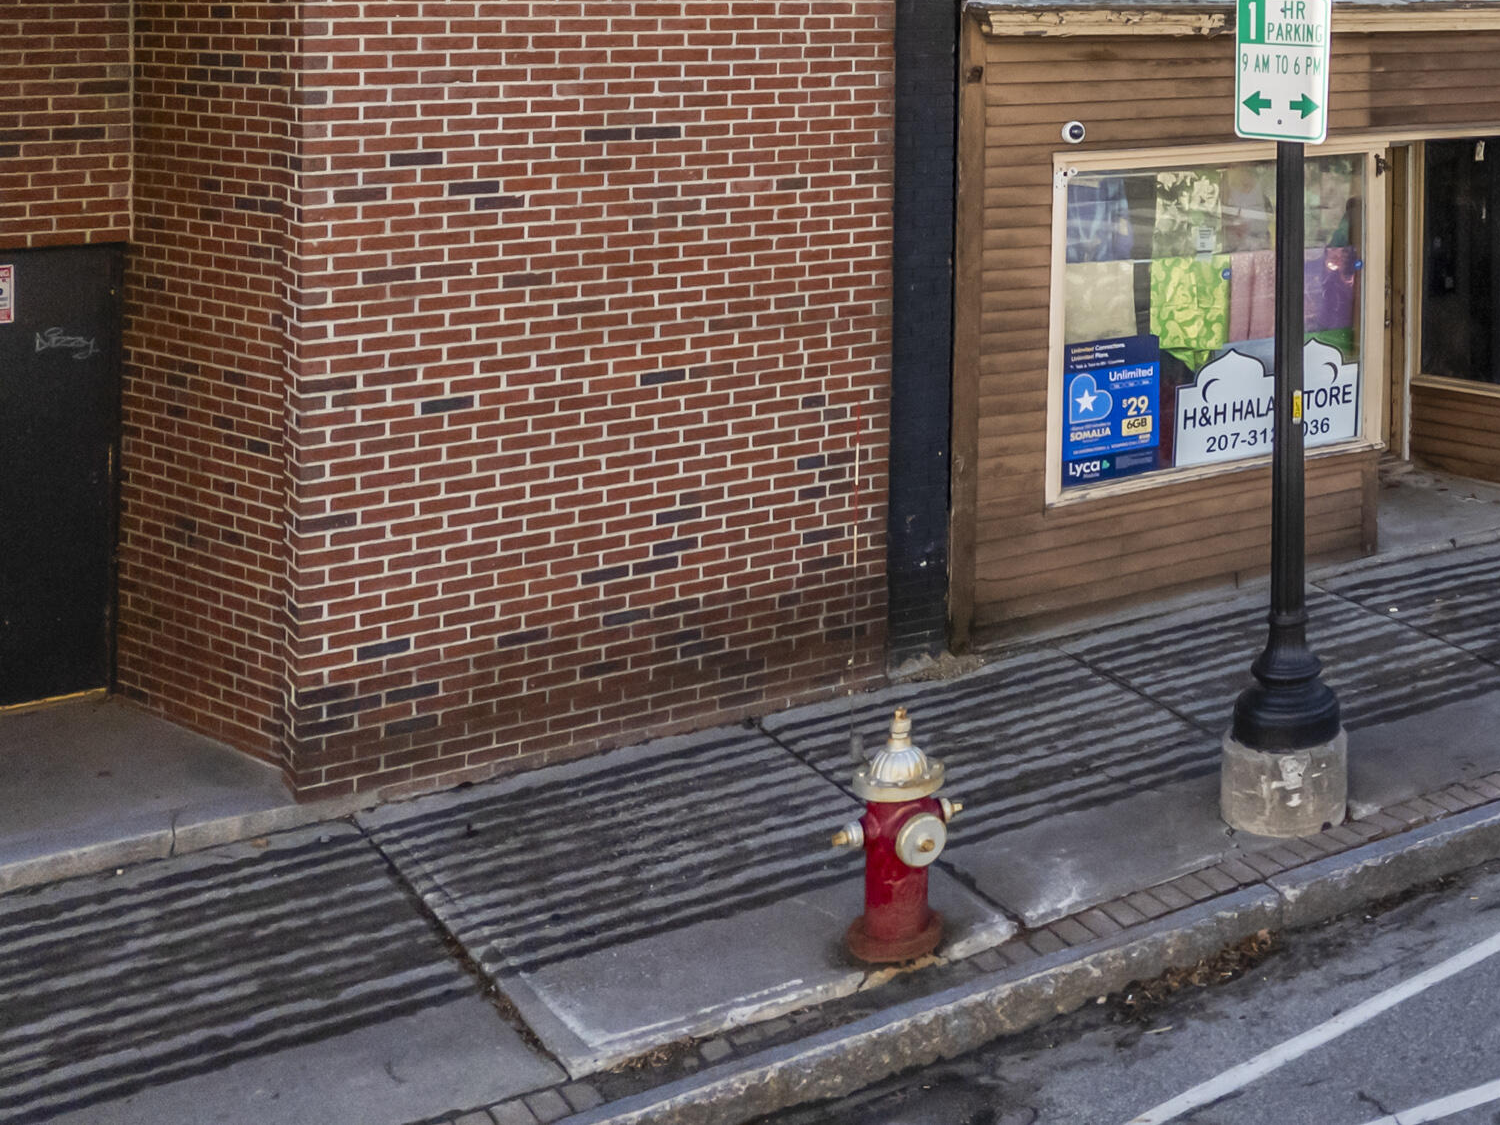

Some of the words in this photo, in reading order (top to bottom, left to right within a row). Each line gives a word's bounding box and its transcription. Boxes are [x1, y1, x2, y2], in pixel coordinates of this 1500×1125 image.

[1248, 1, 1257, 40] 1
[1284, 0, 1306, 20] HR
[1267, 22, 1322, 43] PARKING
[1242, 53, 1249, 72] 9
[1254, 53, 1270, 73] AM
[1275, 54, 1289, 74] TO
[1293, 56, 1301, 75] 6
[1305, 56, 1321, 75] PM
[1109, 365, 1154, 382] Unlimited
[1122, 395, 1149, 416] $29
[1183, 403, 1227, 430] H&H
[1232, 396, 1275, 422] HALA
[1303, 384, 1353, 410] TORE
[1126, 417, 1147, 430] 6GB
[1070, 427, 1112, 442] SOMALIA
[1069, 460, 1101, 477] Lyca
